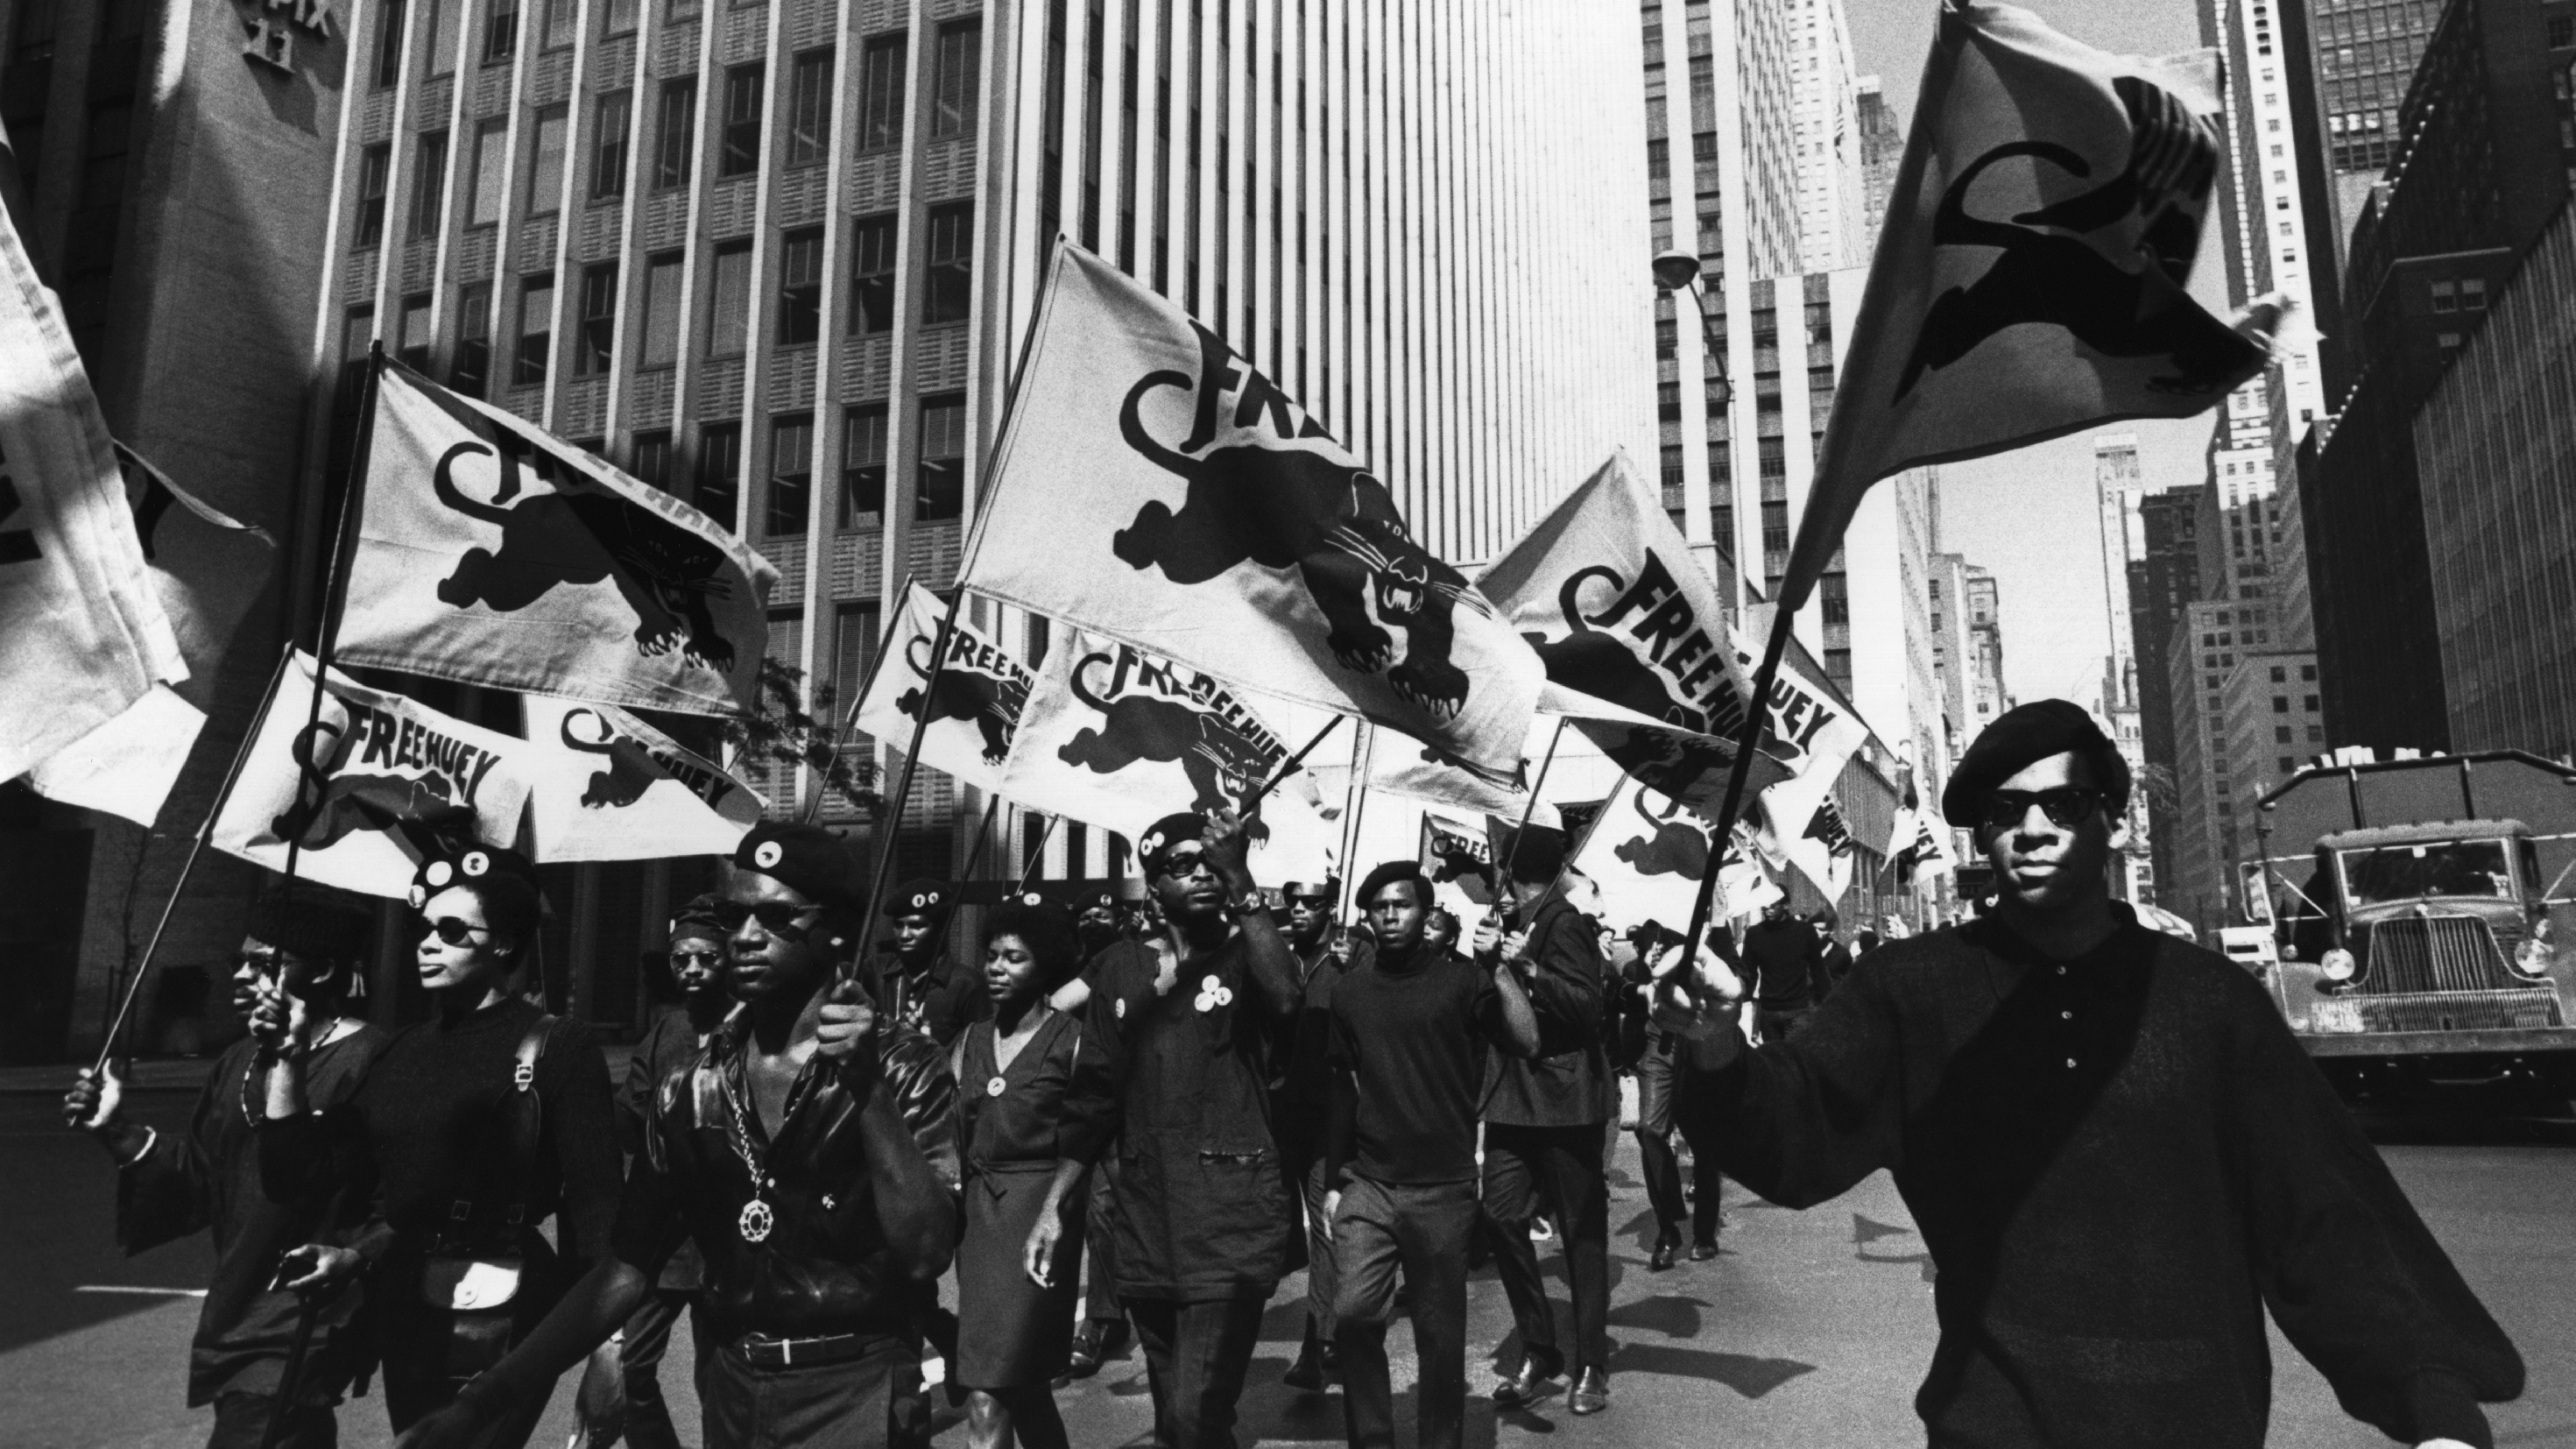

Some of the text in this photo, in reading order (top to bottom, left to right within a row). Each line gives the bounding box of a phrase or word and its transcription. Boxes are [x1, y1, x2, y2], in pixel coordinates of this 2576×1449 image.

[242, 18, 296, 74] 11
[1584, 547, 1726, 700] FREE
[321, 696, 427, 774] FREE
[425, 731, 502, 813] HUEY
[1752, 666, 1837, 755] UEY
[1441, 829, 1491, 862] FREE
